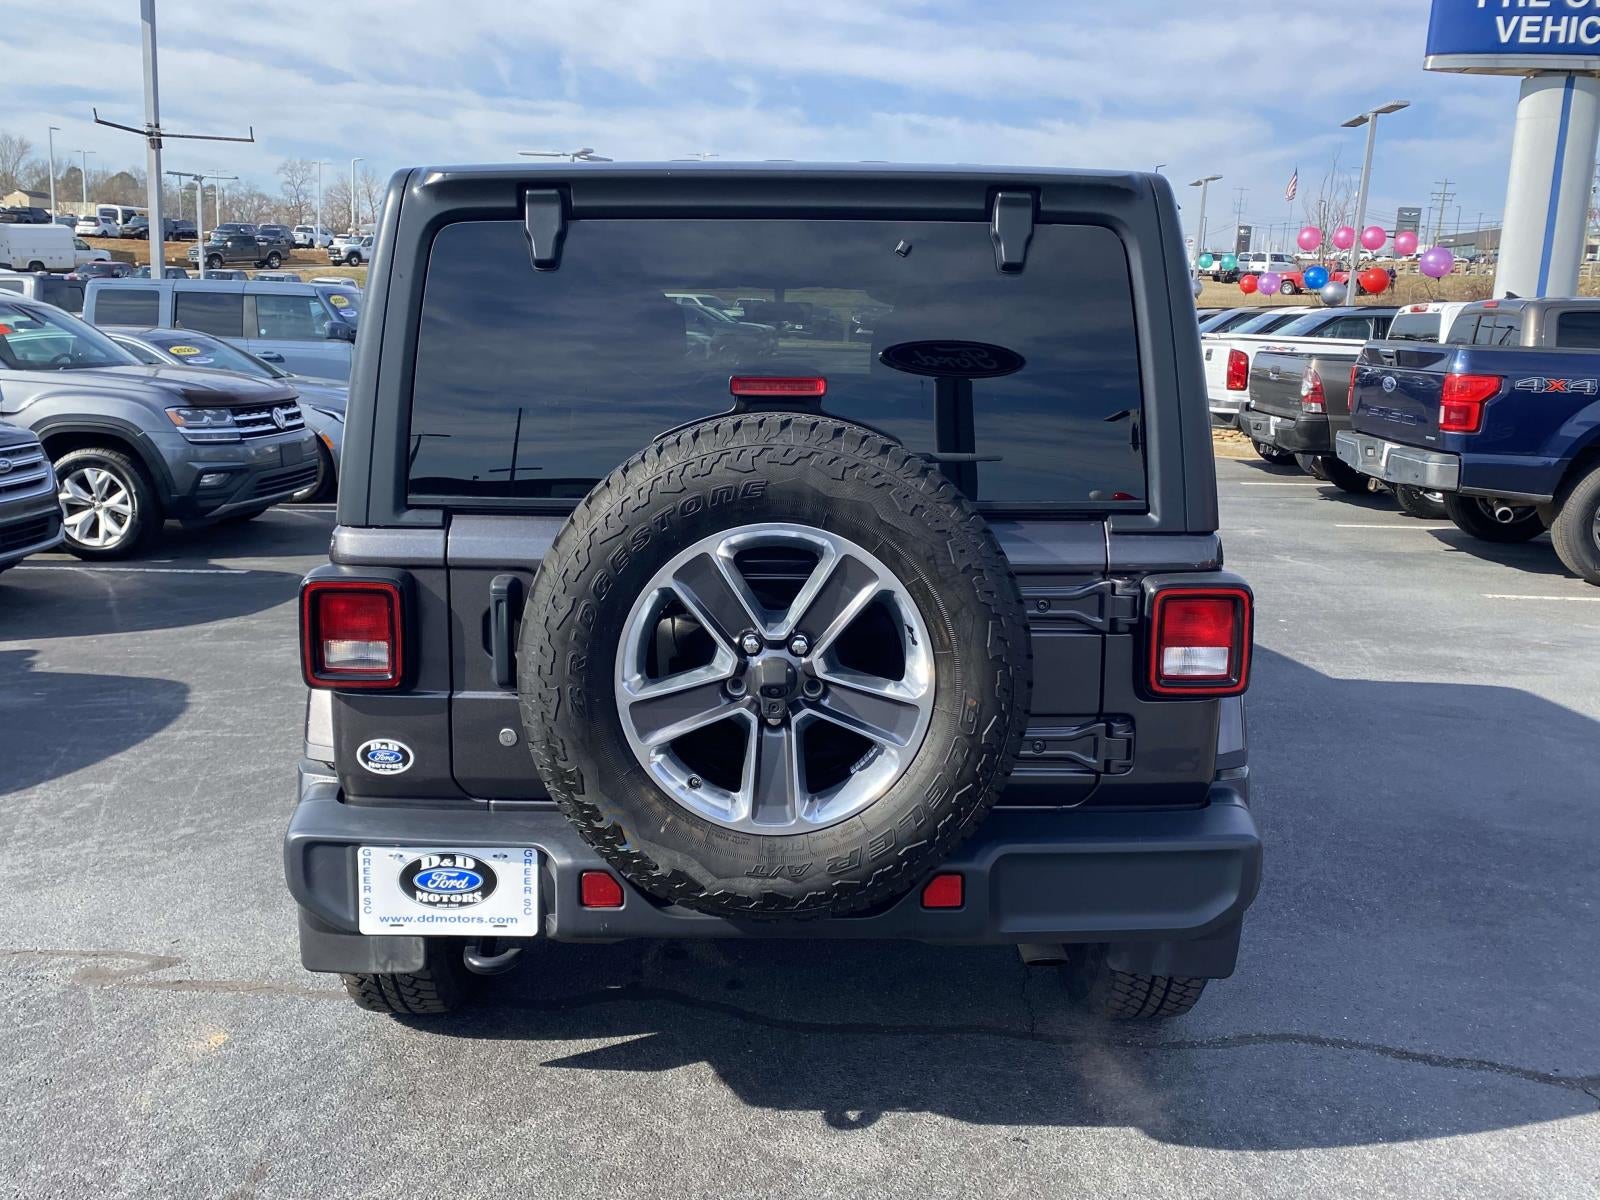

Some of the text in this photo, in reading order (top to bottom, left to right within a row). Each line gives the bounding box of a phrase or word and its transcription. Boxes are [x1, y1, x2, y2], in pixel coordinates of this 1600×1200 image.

[1495, 15, 1600, 44] VEHIC
[419, 854, 475, 871] D&D
[362, 848, 373, 915] GREER SC
[427, 871, 469, 889] Ford
[523, 849, 533, 916] GREER SC
[415, 890, 483, 904] MOTORS
[379, 914, 519, 925] www.ddmotors.com
